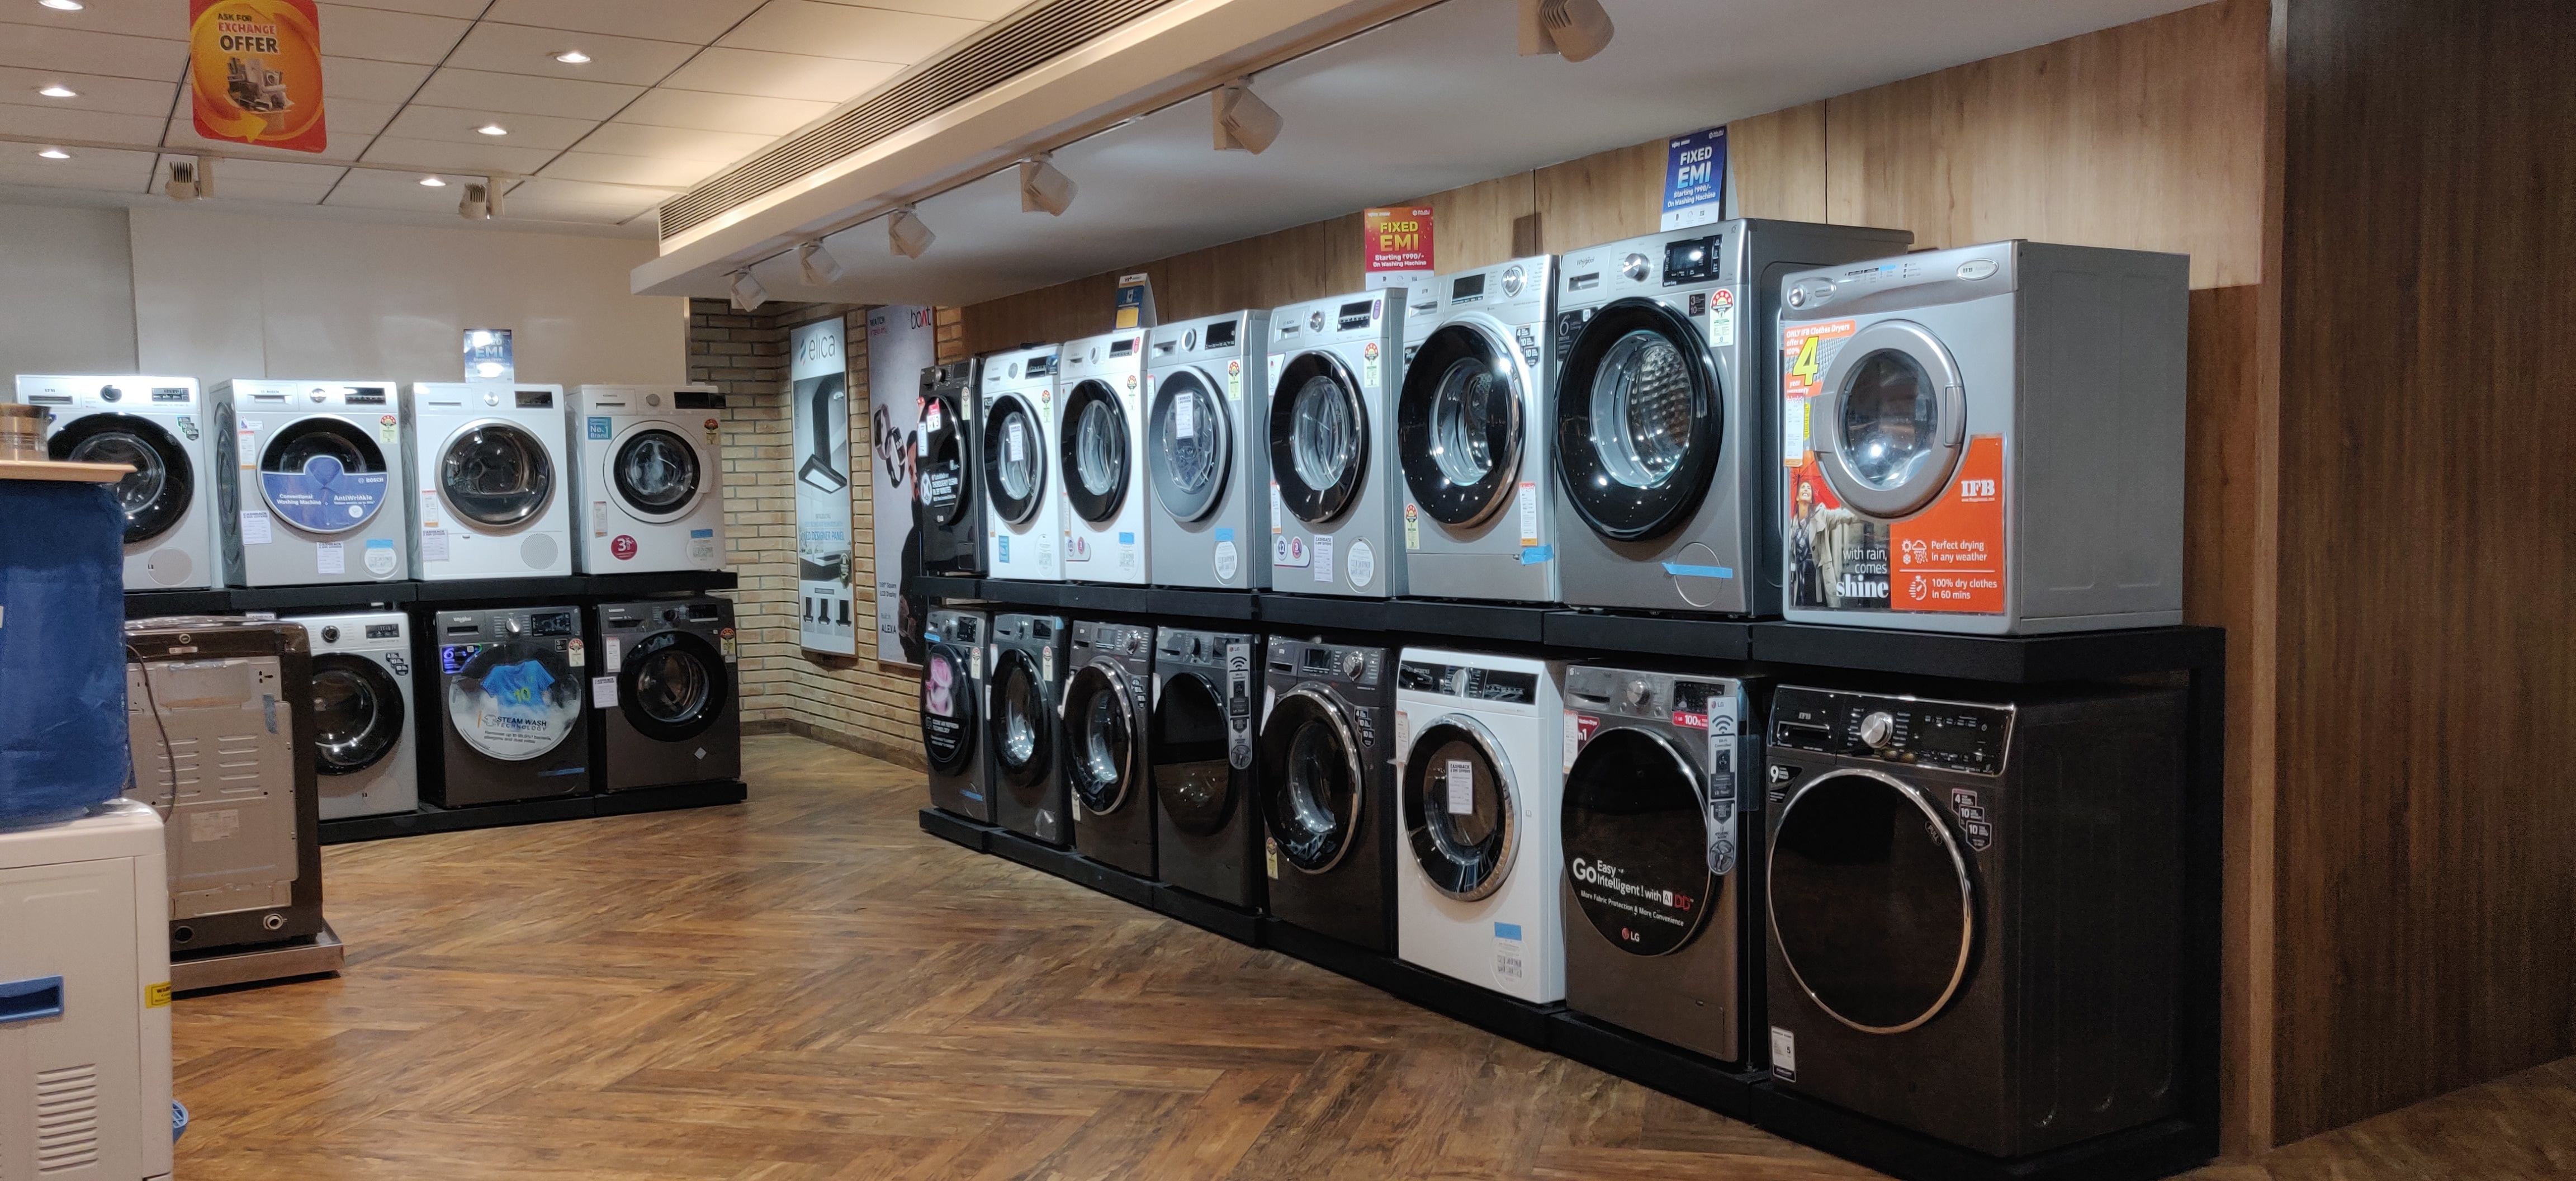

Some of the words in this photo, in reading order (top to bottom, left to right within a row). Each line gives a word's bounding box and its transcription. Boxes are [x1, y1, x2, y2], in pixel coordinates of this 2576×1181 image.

[219, 22, 276, 34] EXCHANGE
[220, 35, 278, 53] OFFER
[1680, 146, 1712, 166] FIXED
[1678, 161, 1711, 189] EMI
[1674, 187, 1693, 199] Starting
[1675, 197, 1695, 206] Washing
[1696, 192, 1716, 202] Machine
[1380, 221, 1418, 233] FIXED
[1380, 234, 1419, 252] EMI
[1690, 296, 1696, 305] 3
[1690, 306, 1697, 314] 10
[1787, 329, 1800, 338] ONLY
[1810, 326, 1831, 335] Clothes
[1831, 324, 1850, 333] Dryers
[809, 334, 835, 361] elica
[1521, 338, 1527, 346] 10
[475, 346, 503, 358] EMI
[1525, 349, 1531, 357] 10
[1792, 336, 1819, 386] 4
[1961, 480, 1995, 497] IFB
[617, 538, 626, 551] 3
[1931, 539, 1959, 550] Perfect
[1960, 539, 1985, 551] drying
[1843, 546, 1864, 560] with
[1867, 547, 1887, 561] rain,
[1940, 554, 1954, 564] any
[1956, 552, 1987, 561] weather
[1855, 564, 1887, 574] comes
[1836, 574, 1889, 598] shine
[1932, 578, 1954, 588] 100%
[1955, 578, 1967, 590] dry
[1969, 578, 1997, 588] clothes
[1940, 590, 1951, 599] 60
[1953, 590, 1971, 599] mins
[1684, 714, 1701, 726] 100%
[1770, 765, 1779, 783] 9
[1954, 793, 1961, 804] 4
[1961, 807, 1970, 818] 10
[1969, 824, 1978, 835] 10
[1573, 857, 1597, 883] Go
[1597, 859, 1617, 877] Easy
[1645, 889, 1661, 903] with
[1581, 890, 1593, 900] More
[1593, 893, 1608, 904] Fabric
[1608, 897, 1633, 912] Protection
[1639, 907, 1652, 919] More
[1653, 911, 1684, 927] Convenience
[1631, 931, 1640, 942] LG
